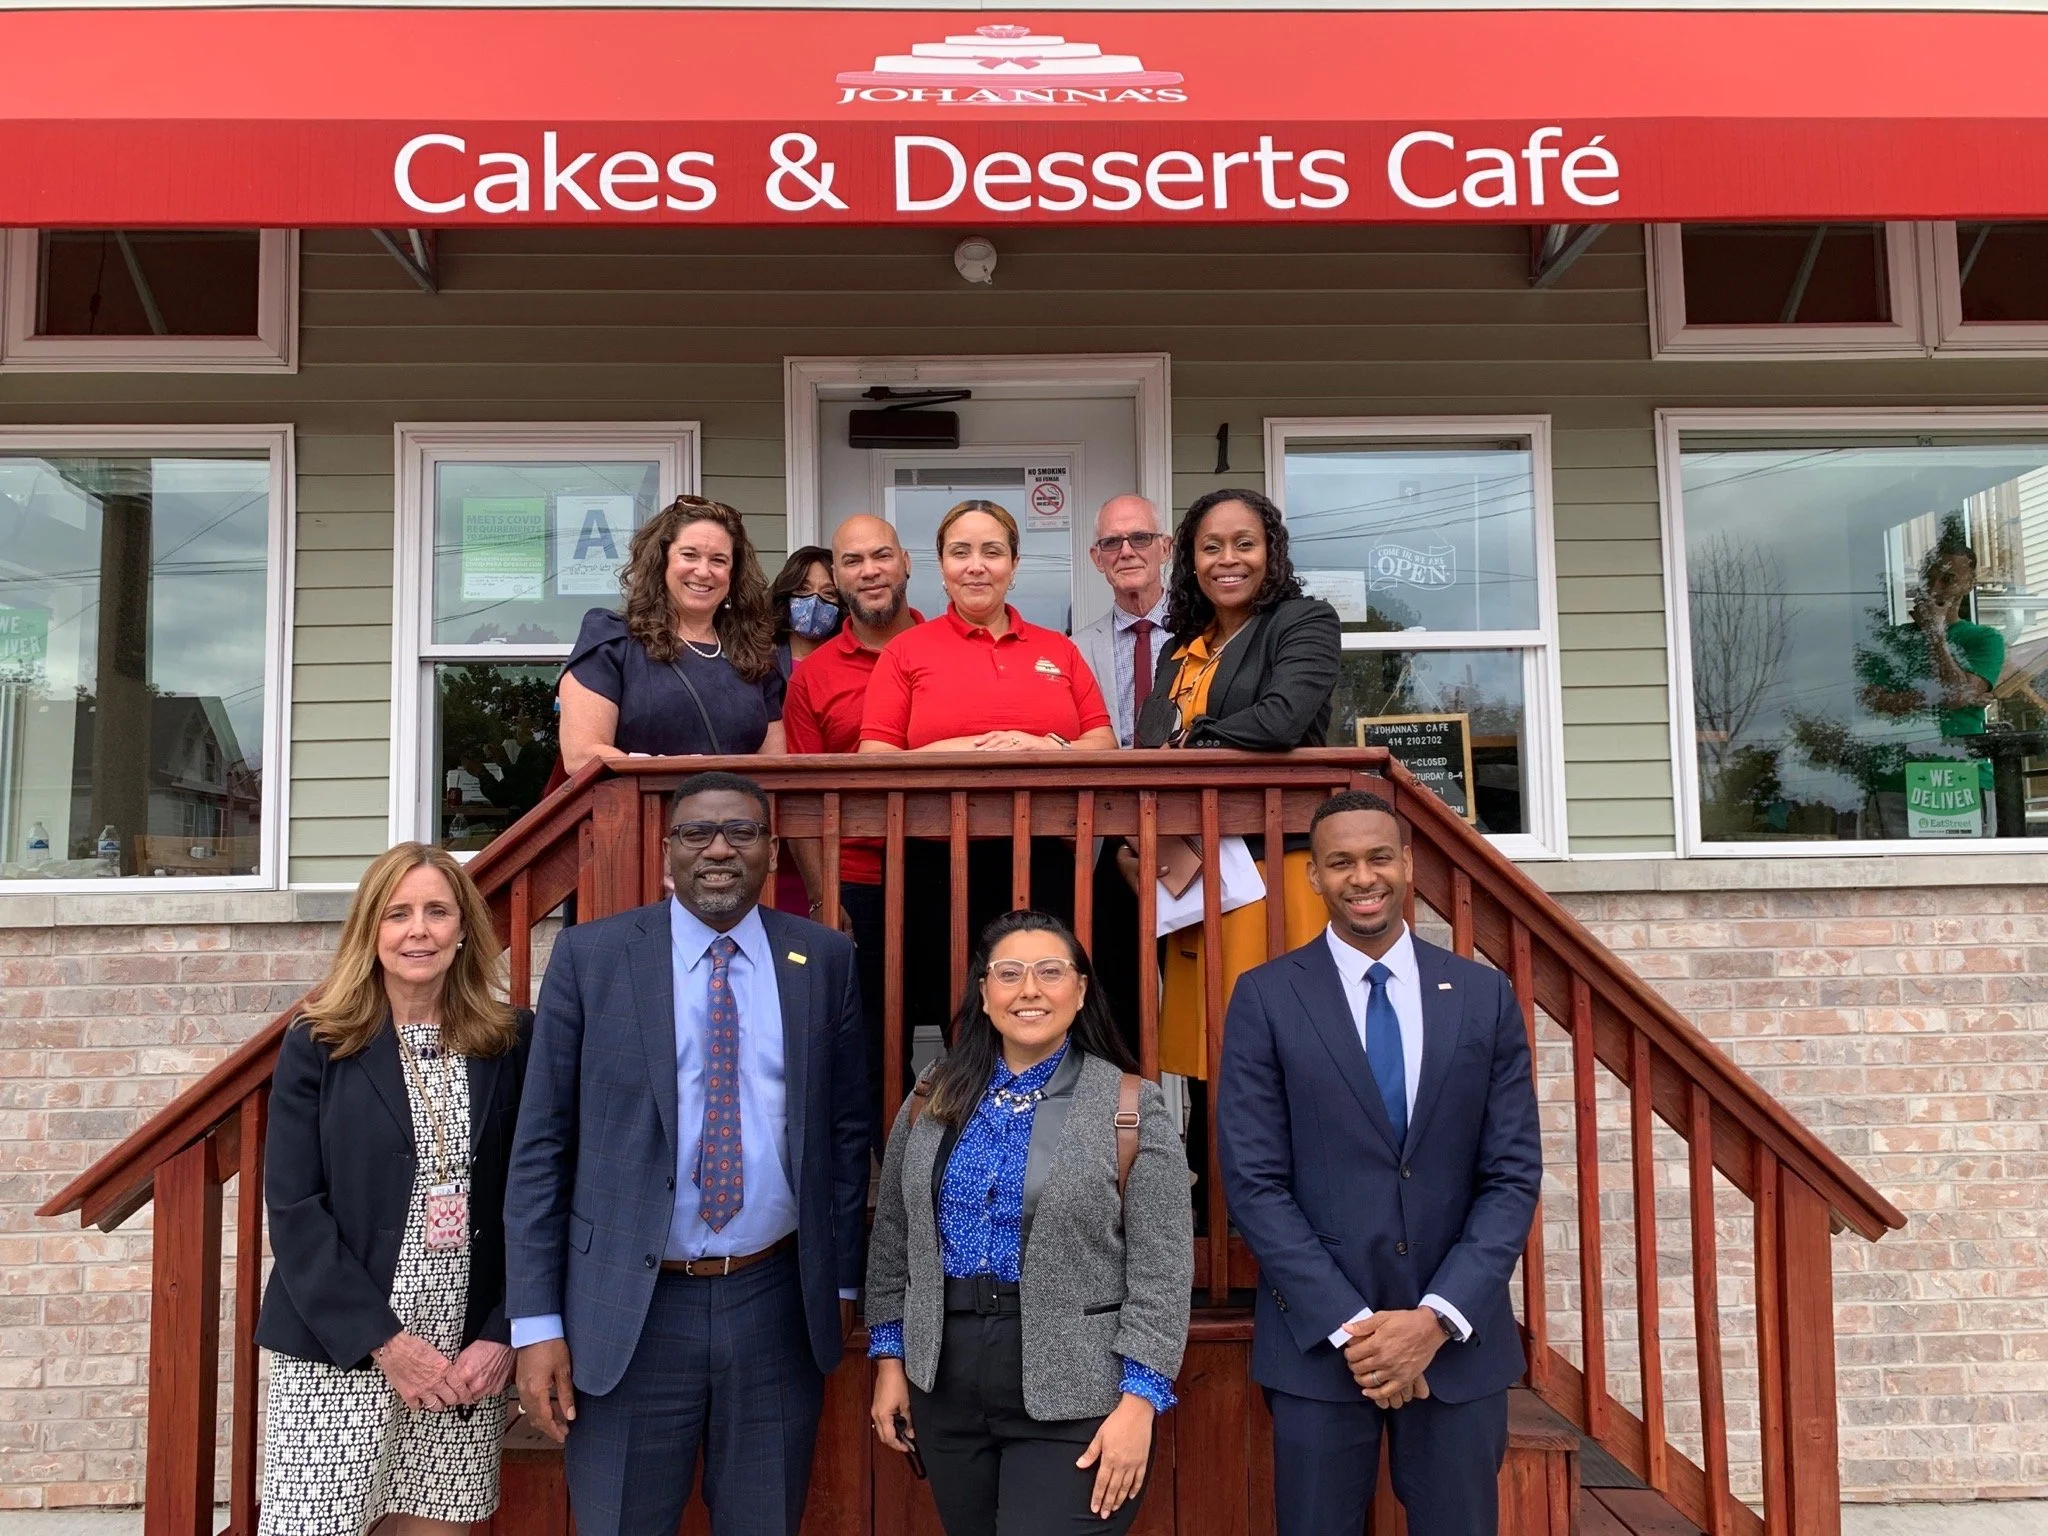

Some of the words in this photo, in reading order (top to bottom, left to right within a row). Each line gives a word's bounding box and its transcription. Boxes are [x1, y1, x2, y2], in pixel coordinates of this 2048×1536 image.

[837, 87, 1189, 105] JOHANNA'S
[393, 132, 718, 214] Cakes
[765, 132, 850, 212] &
[894, 134, 1351, 212] Desserts
[1387, 126, 1620, 209] Café
[1215, 422, 1230, 473] 1
[1037, 467, 1066, 475] SMOKING
[466, 515, 504, 524] MEETS
[507, 515, 541, 524] COVID
[466, 525, 541, 533] REQUIREMENTS
[573, 509, 619, 559] A
[1378, 548, 1400, 557] COME
[1414, 555, 1426, 565] WE
[1428, 556, 1444, 565] ARE
[1377, 556, 1447, 584] OPEN
[1, 636, 41, 657] IVER
[1375, 724, 1418, 735] JOHANNA'S
[1426, 723, 1449, 732] CAFE
[1388, 737, 1403, 746] 414
[1406, 736, 1443, 746] 2102702
[1448, 771, 1463, 780] 8-4
[1929, 769, 1954, 787] WE
[1910, 787, 1975, 809] DELIVER
[1930, 818, 1972, 828] EatStreet
